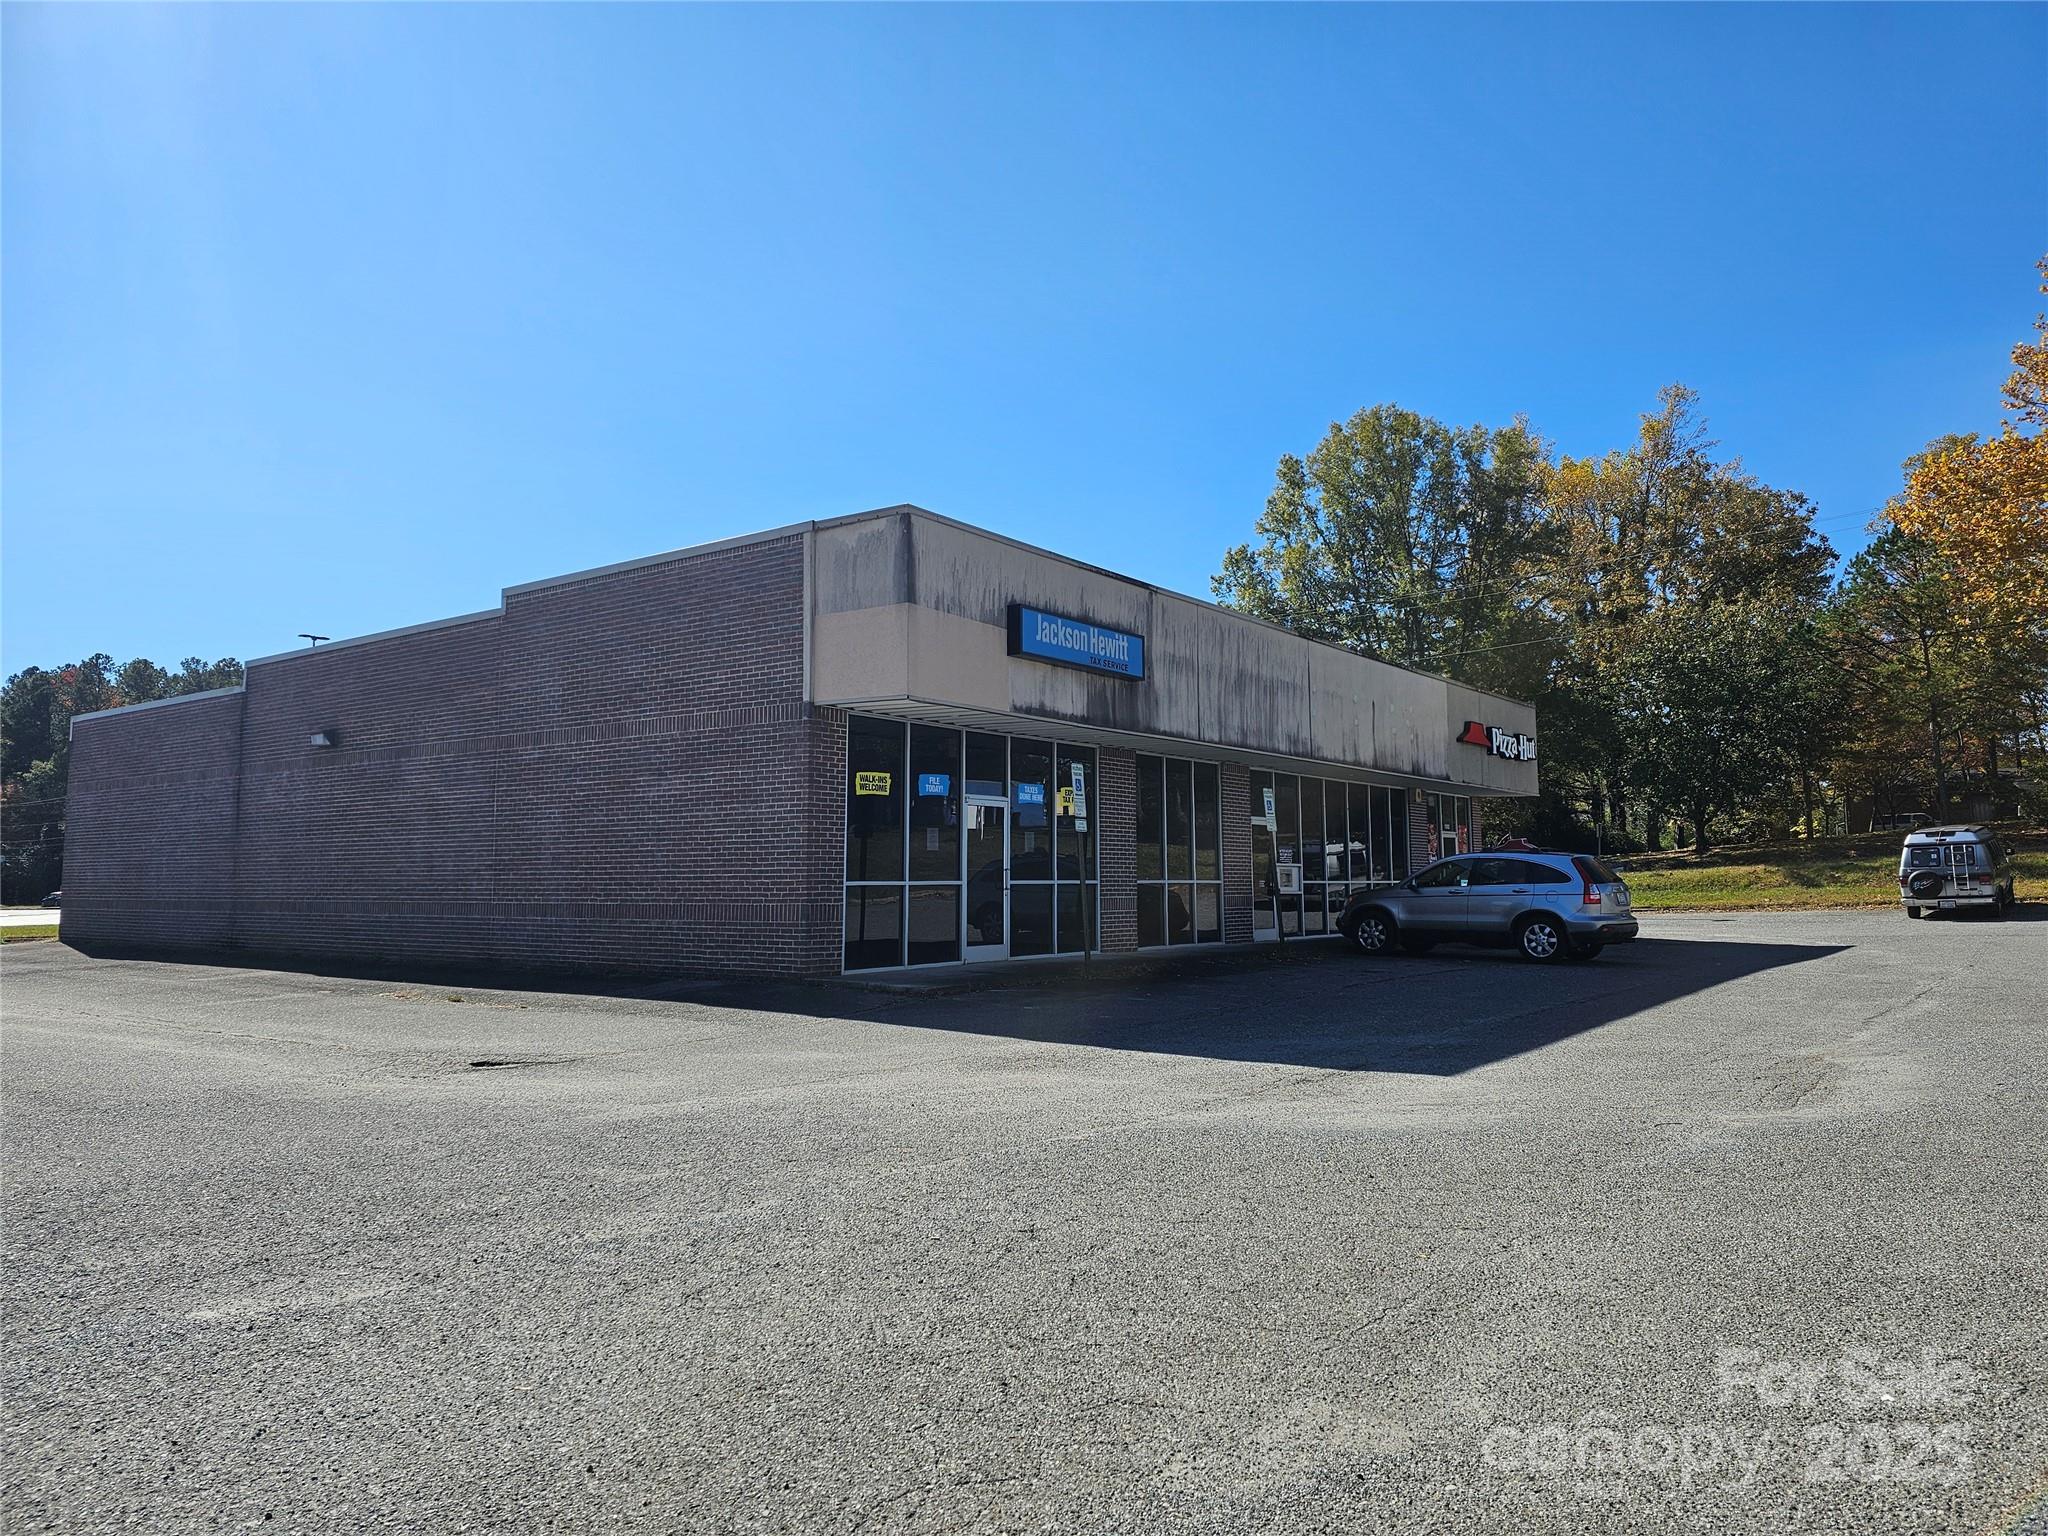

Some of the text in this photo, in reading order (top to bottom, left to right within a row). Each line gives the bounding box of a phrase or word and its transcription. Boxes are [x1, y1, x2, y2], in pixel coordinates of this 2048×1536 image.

[1036, 614, 1129, 661] Jackson Hewitt
[1090, 656, 1129, 671] TAX SERVICE
[1492, 728, 1536, 760] Pizza Hut
[860, 774, 888, 784] WALK-INS
[929, 776, 940, 785] FILE
[860, 783, 888, 792] WELCOME
[926, 784, 943, 793] TODAY!
[1024, 785, 1038, 794] TAXES
